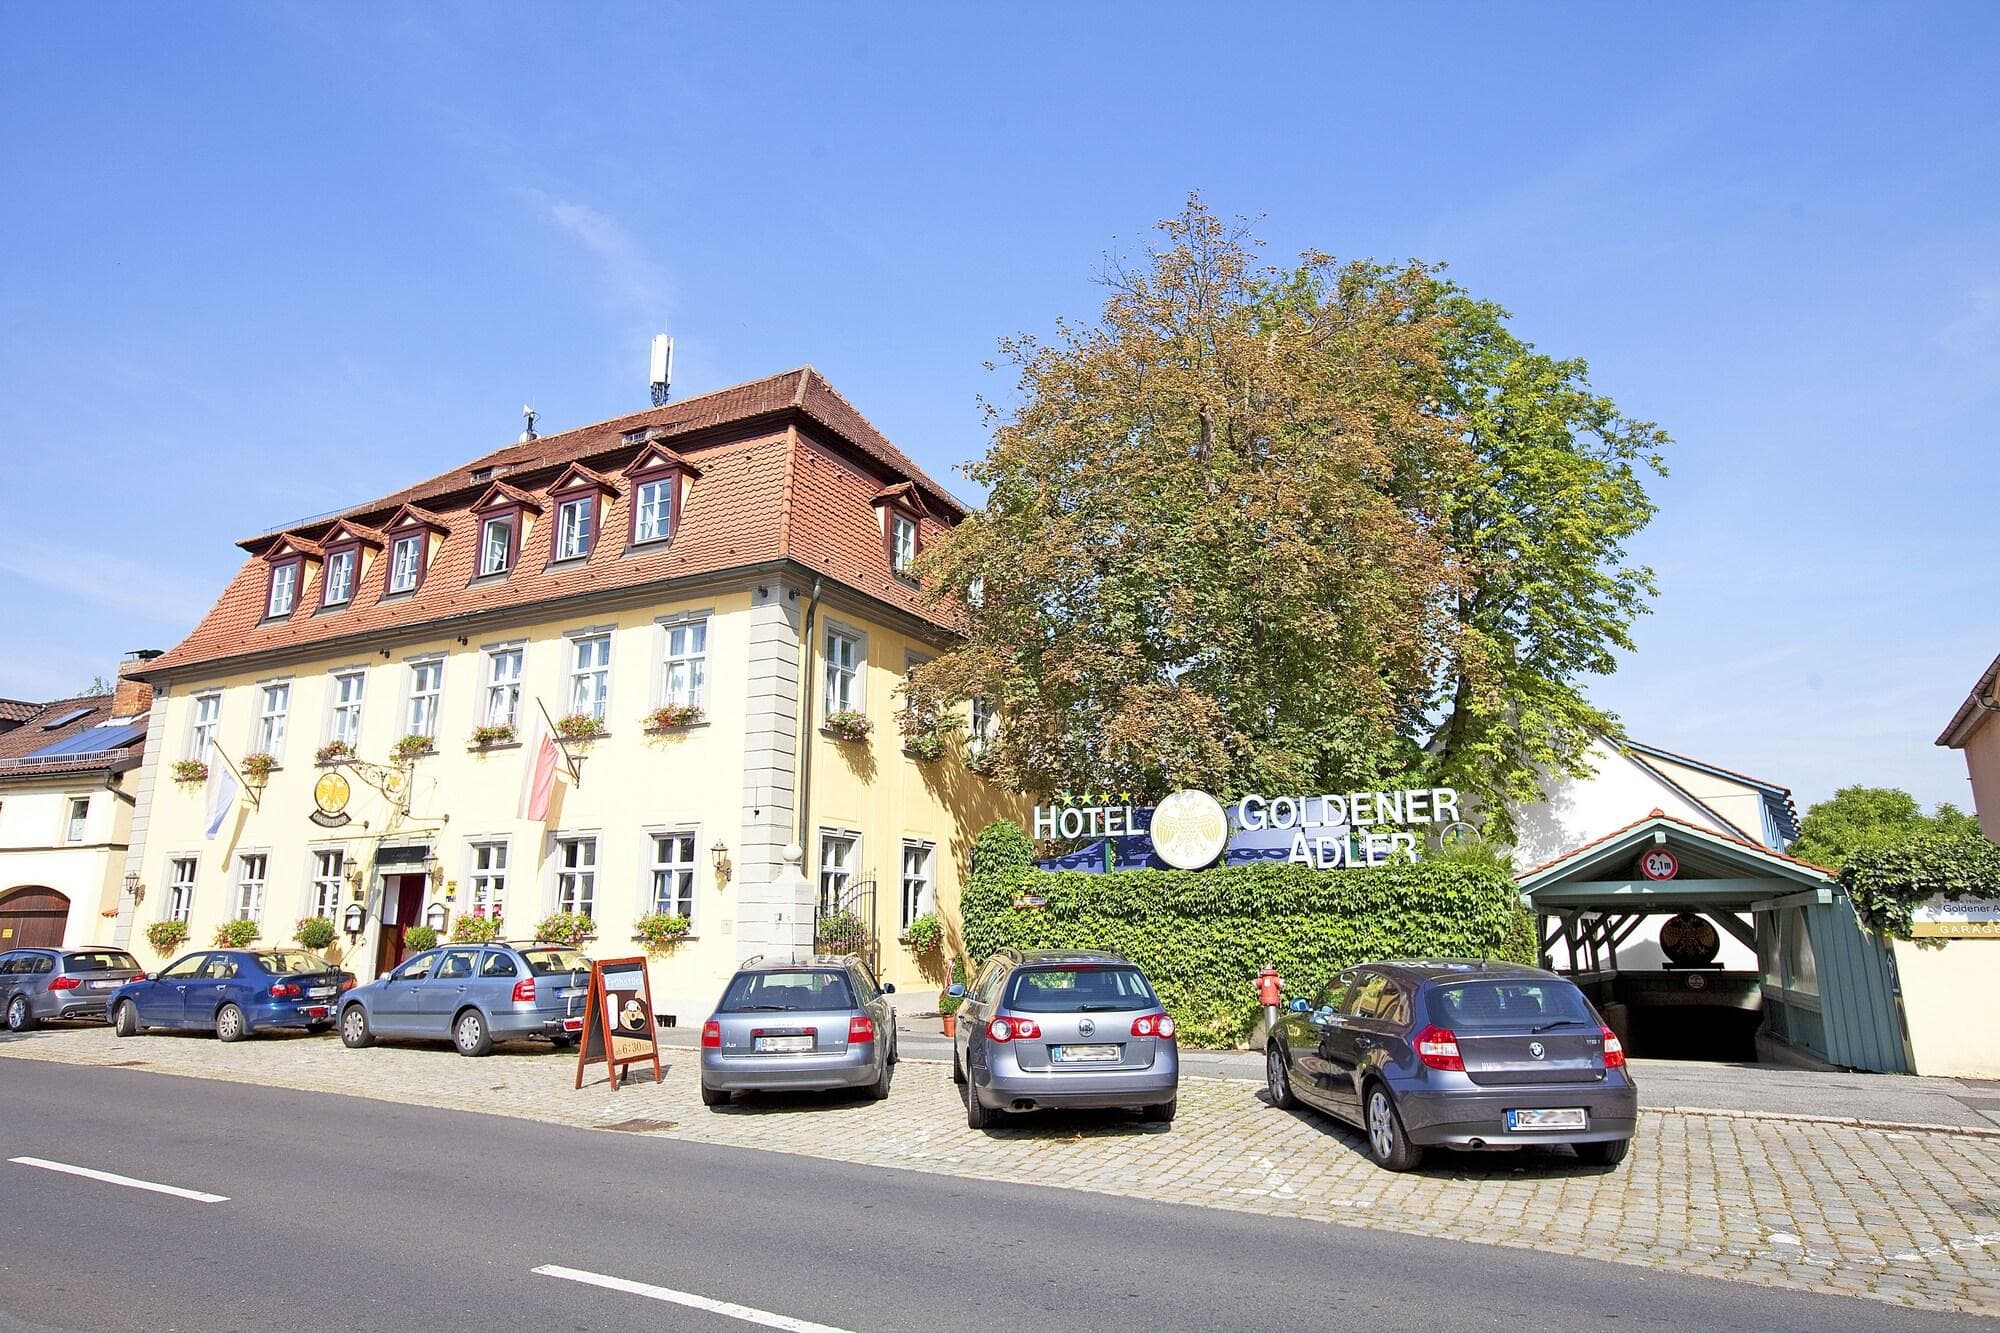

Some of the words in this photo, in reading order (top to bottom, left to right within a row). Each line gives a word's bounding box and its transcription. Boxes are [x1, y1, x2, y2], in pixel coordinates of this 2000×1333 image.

[1034, 805, 1144, 840] HOTEL
[1238, 787, 1460, 831] GOLDENER
[1287, 832, 1418, 869] ADLER
[1943, 904, 1990, 913] Goldener
[622, 1041, 642, 1054] 6:30
